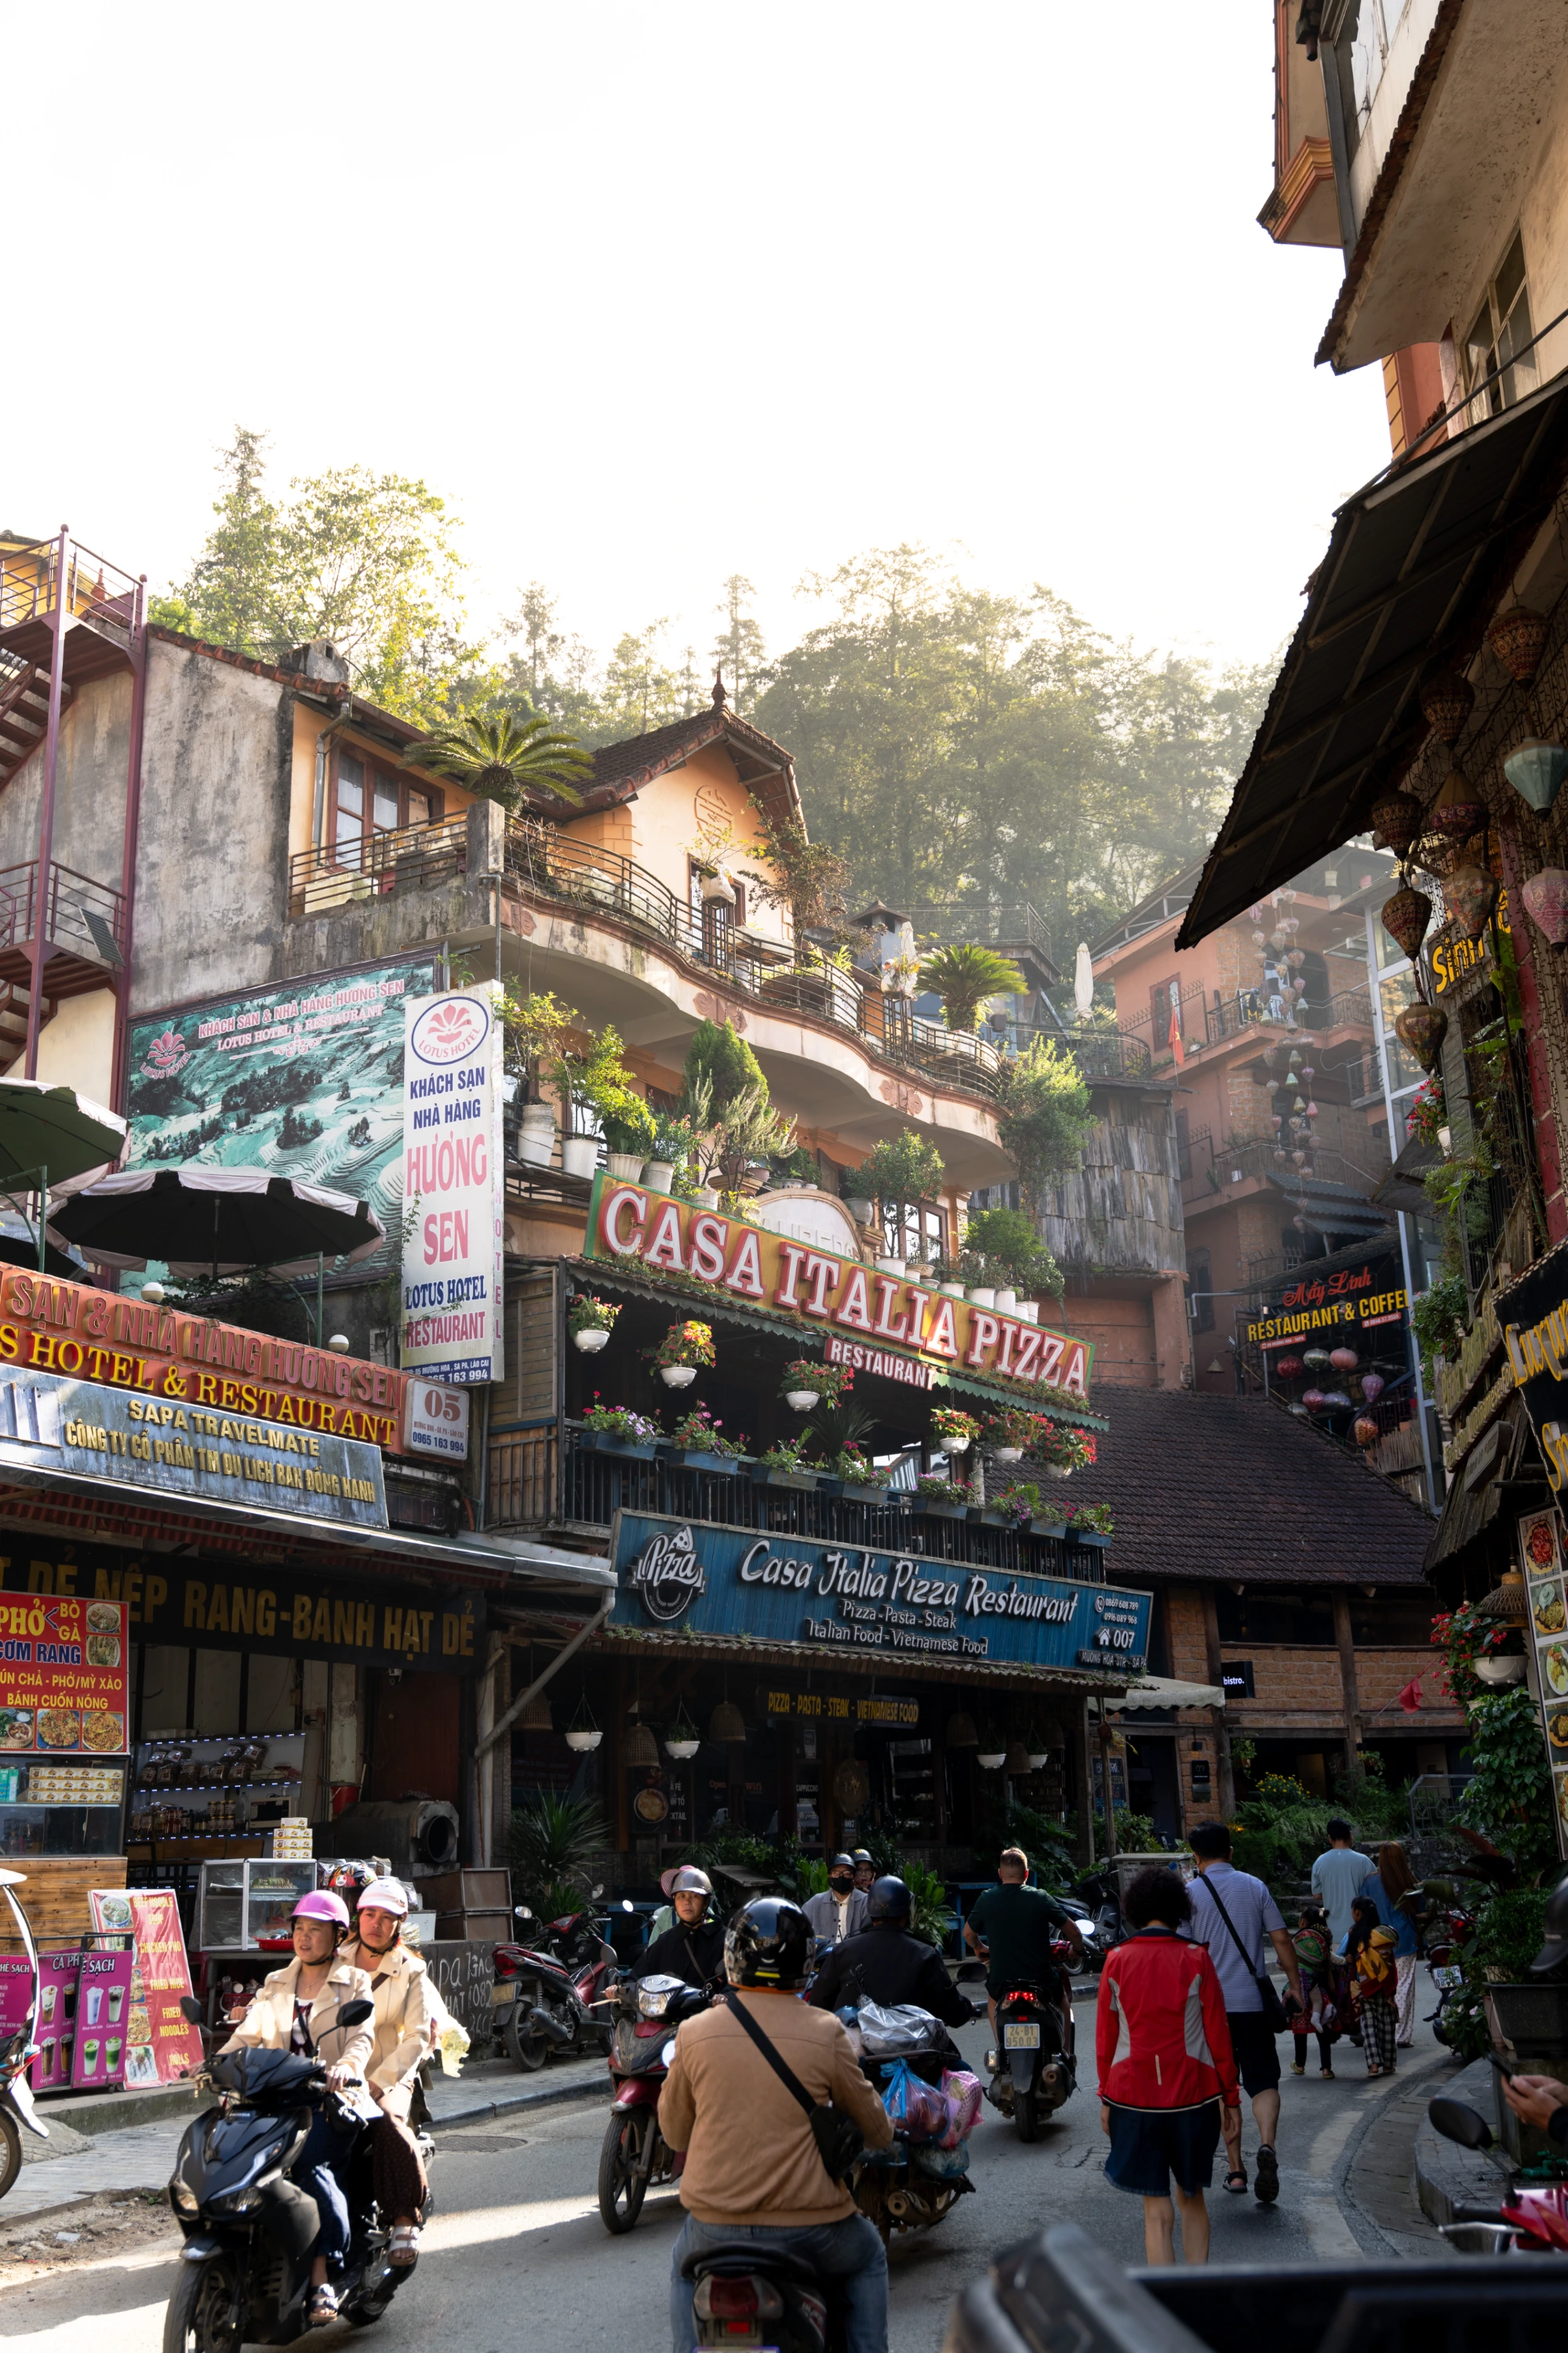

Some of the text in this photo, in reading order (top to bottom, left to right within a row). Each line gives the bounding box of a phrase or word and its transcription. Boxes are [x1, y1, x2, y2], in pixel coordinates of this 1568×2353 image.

[262, 1009, 272, 1024] &
[301, 995, 333, 1014] HÀNG
[380, 978, 405, 997] SEN
[216, 1004, 384, 1052] LOTUS HOTEL & RESTAURANT
[418, 1027, 482, 1058] LOTUS HOTEL
[139, 1050, 193, 1079] LOTUS HOTEL
[410, 1066, 485, 1100] KHÁCH SẠN
[413, 1098, 481, 1129] NHÀ HÀNG
[406, 1130, 487, 1197] HƯƠNG
[424, 1209, 469, 1266] SEN
[405, 1275, 487, 1311] LOTUS HOTEL
[598, 1186, 1089, 1400] CASA ITALIA PIZZA
[1328, 1266, 1373, 1295] Linh
[406, 1311, 486, 1348] RESTAURANT
[1248, 1305, 1341, 1342] RESTAURANT
[1344, 1302, 1355, 1321] &
[7, 1275, 402, 1409] SẠN & NHÀ HÀNG HƯƠNG SEN
[448, 1369, 488, 1383] 163 994
[470, 1359, 480, 1368] LÀO
[480, 1358, 489, 1367] CAI
[829, 1339, 937, 1391] RESTAURANT
[27, 1330, 155, 1392] HOTEL
[162, 1365, 187, 1397] &
[195, 1372, 398, 1446] RESTAURANT
[424, 1389, 461, 1422] 05
[129, 1399, 320, 1457] SAPA TRAVELMATE
[413, 1431, 464, 1453] 0965 163 994
[65, 1418, 107, 1452] CÔNG
[107, 1431, 127, 1457] TY
[129, 1427, 151, 1460] CỔ
[197, 1448, 220, 1473] TM
[222, 1453, 242, 1477] DU
[642, 1534, 700, 1587] Pizza
[740, 1538, 1079, 1623] Casa Italia Pizza Restaurant
[0, 1598, 80, 1636] PHỞ BÒ
[842, 1601, 957, 1629] Pizza Pasta Steak
[1104, 1613, 1115, 1621] 0916
[1127, 1616, 1137, 1624] 968
[1130, 1602, 1139, 1610] 789
[59, 1622, 81, 1642] GÀ
[384, 1606, 435, 1661] HẠT
[442, 1599, 475, 1657] DẺ
[809, 1620, 988, 1655] Italian Food Vietnamese Food
[1113, 1629, 1135, 1648] 007
[36, 1642, 82, 1665] RANG
[0, 1668, 15, 1684] ÚN
[18, 1670, 42, 1686] CHẢ
[99, 1675, 122, 1690] XÀO
[1223, 1676, 1245, 1686] bistro.
[7, 1690, 108, 1709] BÁNH CUỐN NÓNG
[768, 1691, 919, 1723] PIZZA PASTA STEAK VIETNAMESE FOOD
[709, 1780, 726, 1791] Open
[844, 1820, 855, 1828] 007
[133, 1896, 174, 1908] BEEF NOODLE
[140, 1940, 182, 1954] CHICKEN PHO
[0, 1962, 30, 1975] HÊ SẠCH
[89, 1958, 115, 1976] SẠCH
[150, 1977, 185, 1991] FRIED RICE
[162, 2006, 181, 2019] FRIED
[159, 2023, 190, 2037] NOODLES
[1006, 2036, 1038, 2047] 950.03
[1010, 2025, 1034, 2036] 24-B1
[169, 2053, 190, 2065] ROLLS
